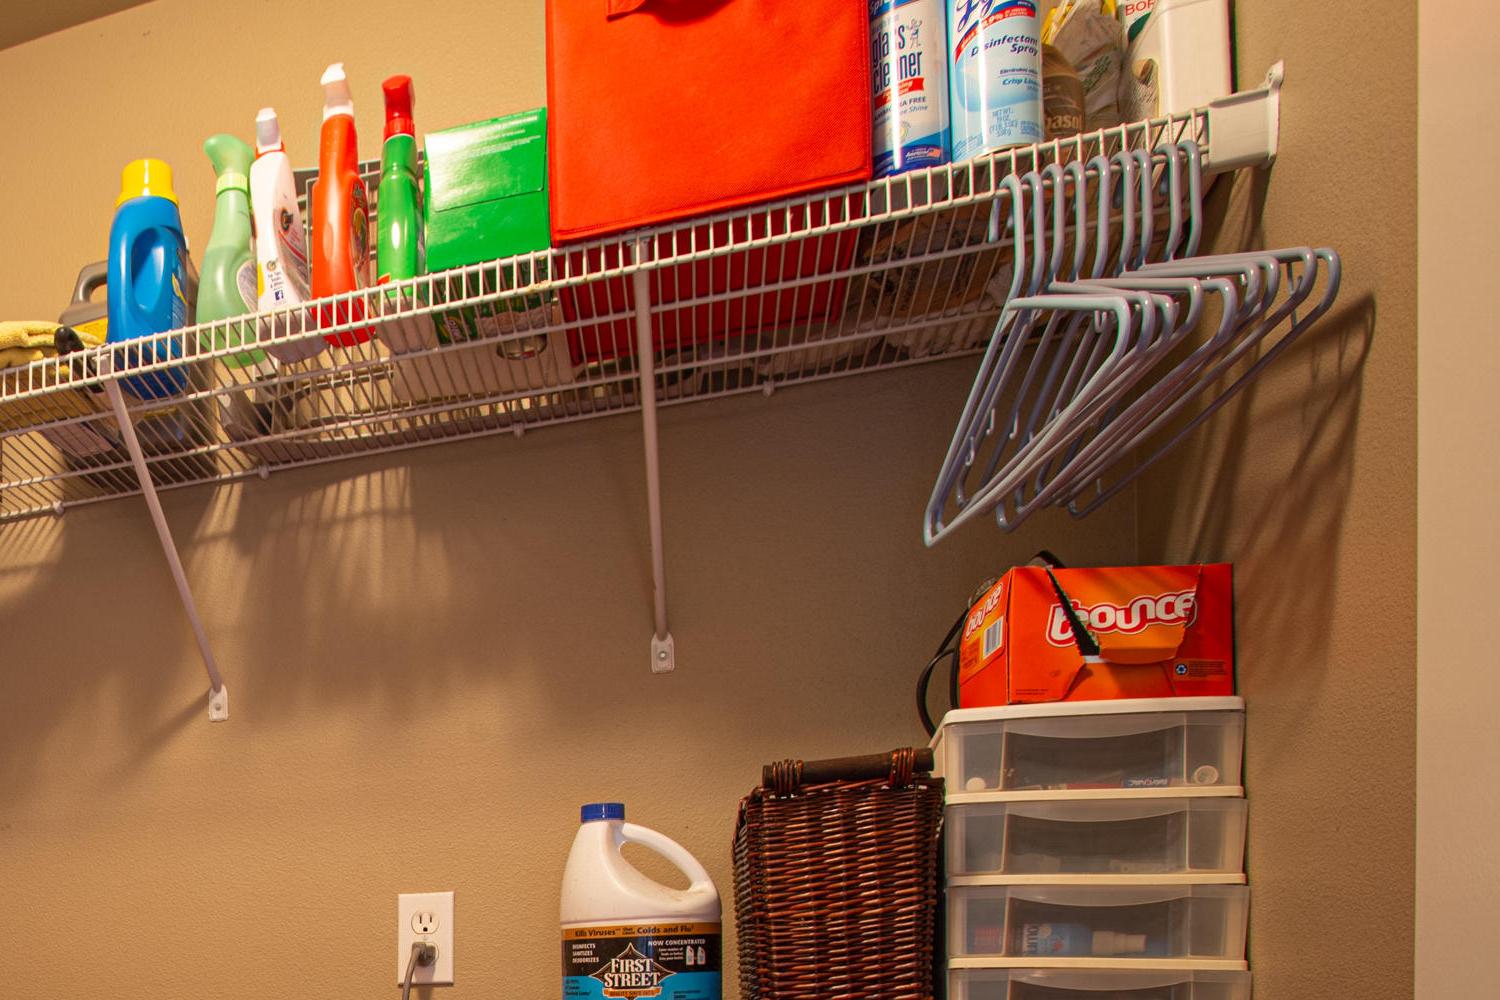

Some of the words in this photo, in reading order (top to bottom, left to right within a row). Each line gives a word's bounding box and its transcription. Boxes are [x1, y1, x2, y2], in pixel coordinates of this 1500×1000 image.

[872, 25, 905, 68] glas
[971, 34, 1038, 58] Dsinfectant
[1010, 43, 1038, 56] Spray
[873, 51, 923, 95] clener
[1002, 78, 1023, 86] Crisp
[909, 96, 926, 105] FREE
[588, 929, 616, 937] Viruses
[637, 926, 660, 934] Colds
[663, 925, 679, 933] and
[665, 938, 706, 946] CONCENTRATED
[611, 958, 654, 973] FIRST
[604, 972, 661, 988] STREET
